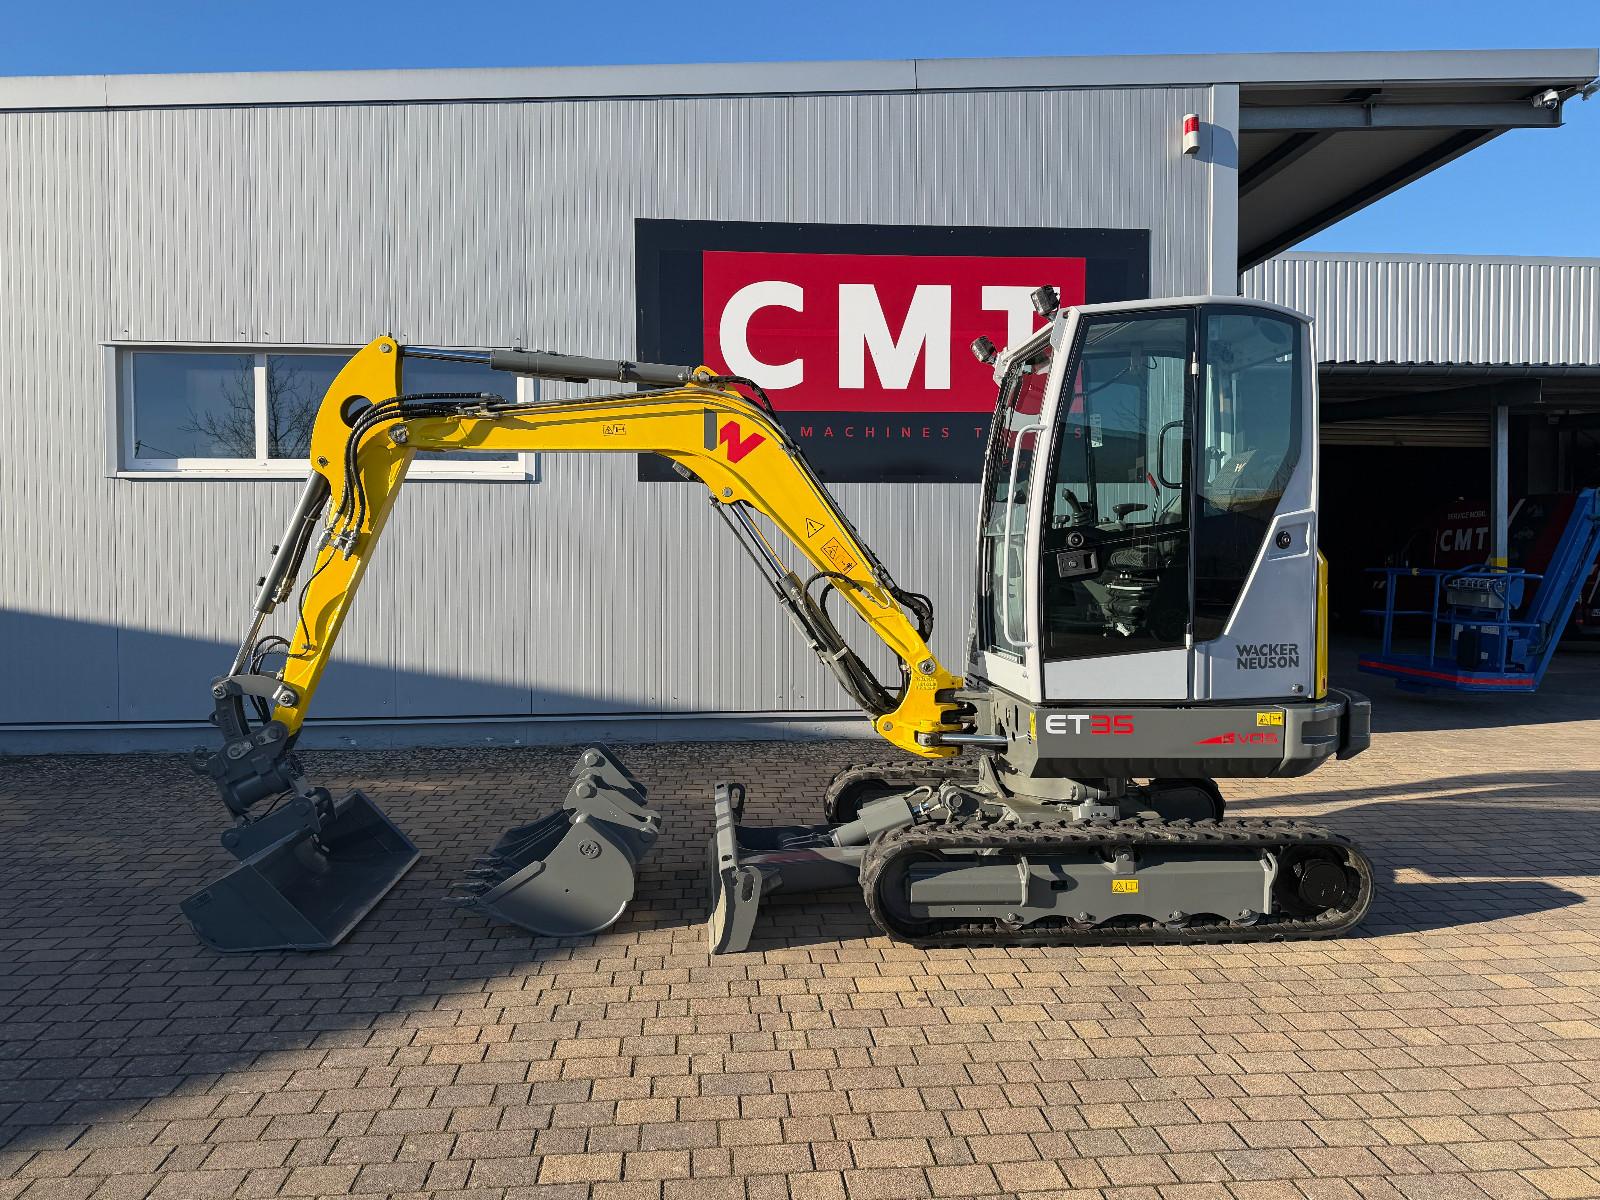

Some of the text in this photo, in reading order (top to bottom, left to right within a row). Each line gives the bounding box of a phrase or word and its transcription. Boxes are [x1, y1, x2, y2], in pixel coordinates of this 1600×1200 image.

[801, 426, 950, 439] MACHINES
[1439, 526, 1489, 552] CMT
[1236, 643, 1299, 657] WACKER
[1237, 656, 1300, 670] NEUSON
[1045, 714, 1136, 736] ET35
